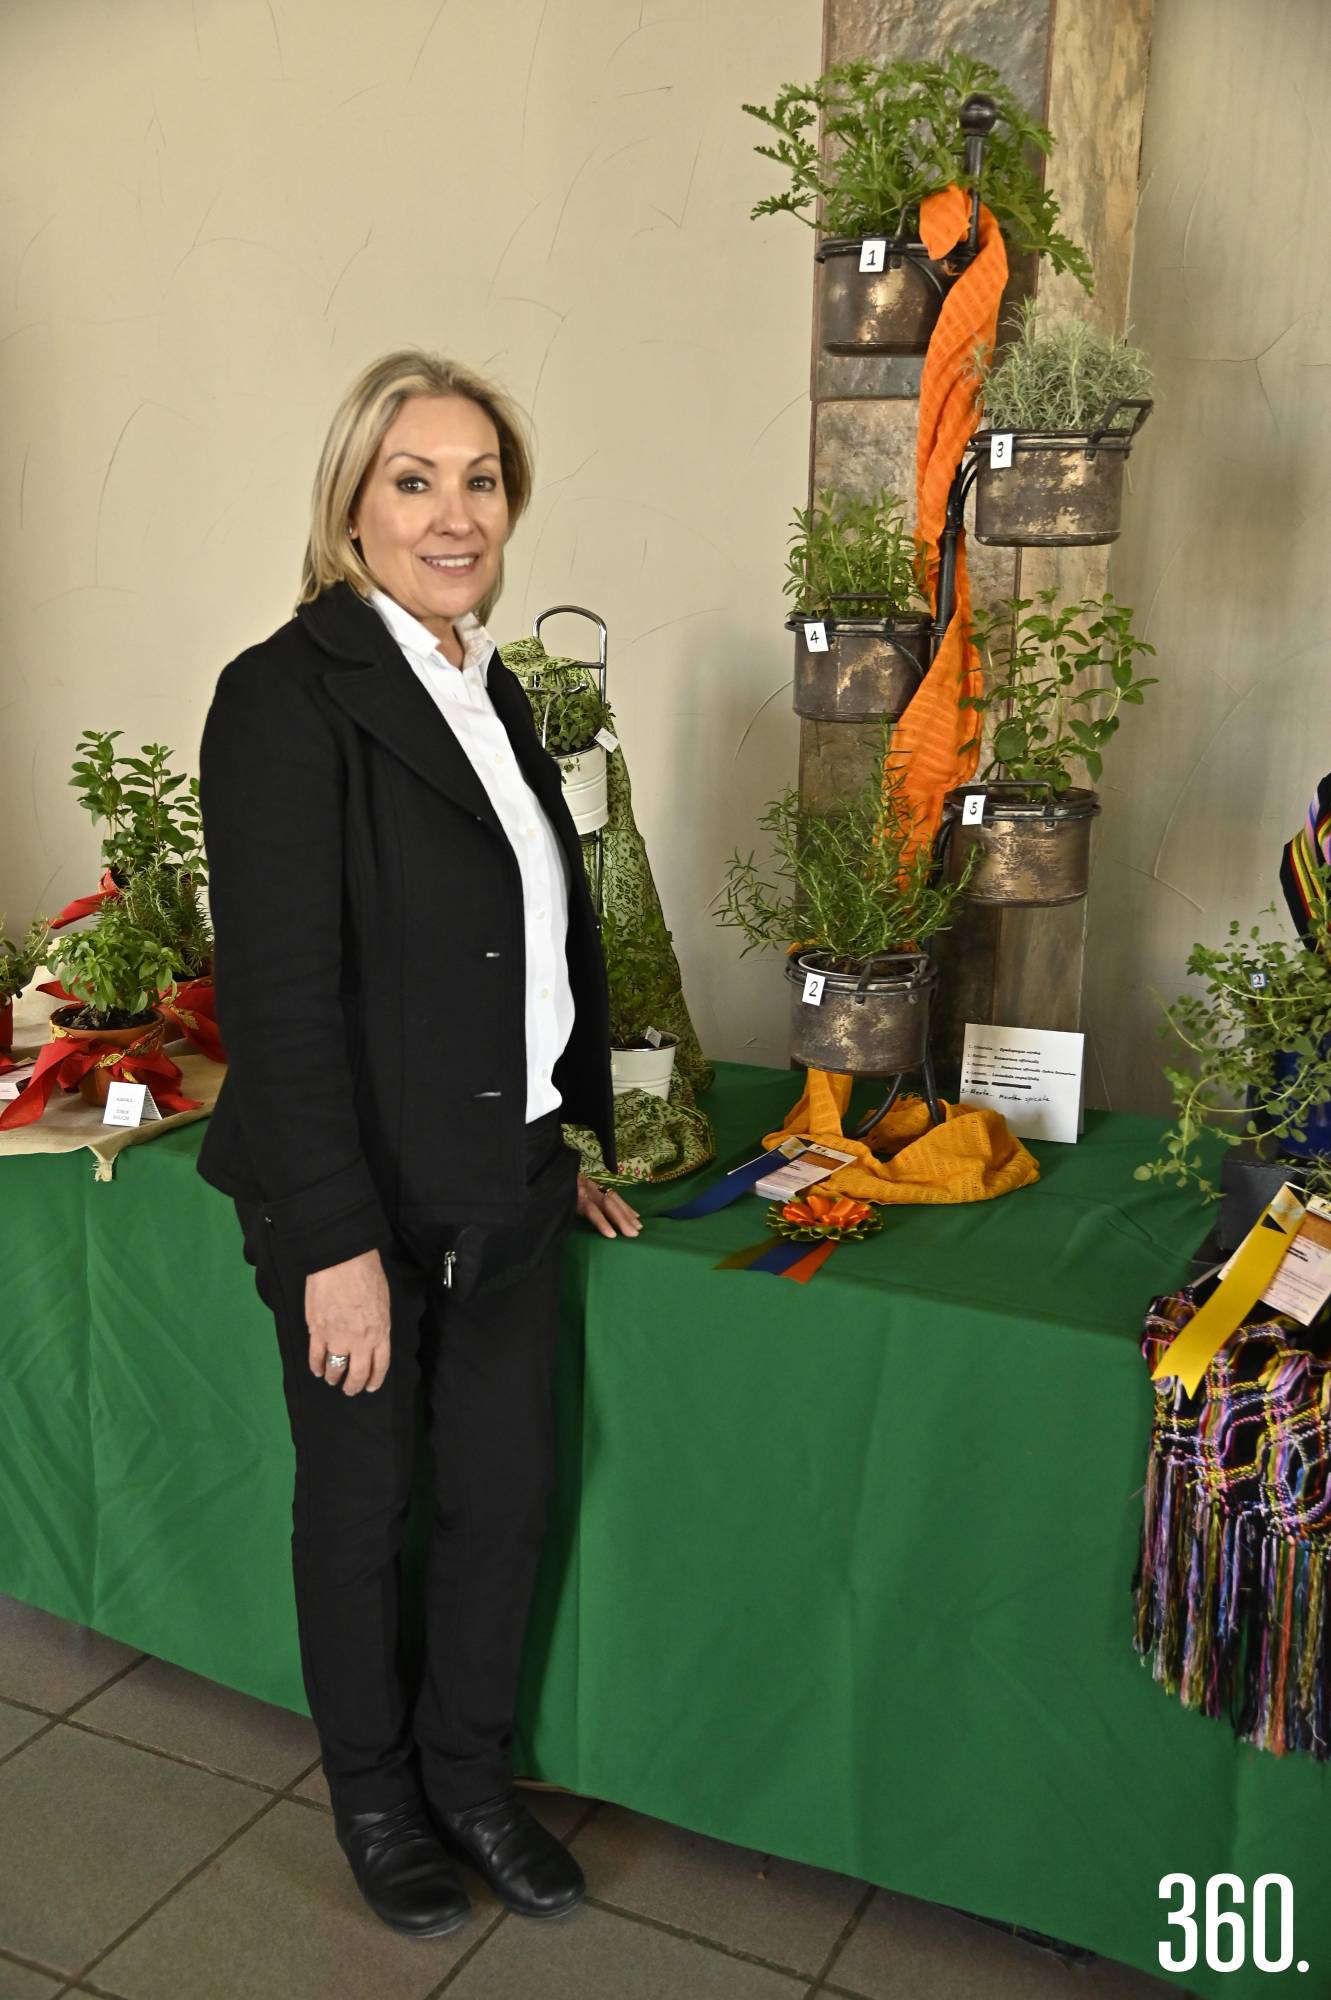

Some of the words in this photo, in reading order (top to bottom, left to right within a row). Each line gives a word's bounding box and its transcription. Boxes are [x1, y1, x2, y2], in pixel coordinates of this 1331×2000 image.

[866, 249, 877, 266] 1
[996, 441, 1005, 458] 3
[809, 631, 819, 644] 4
[969, 802, 978, 815] 5
[809, 981, 819, 997] 2
